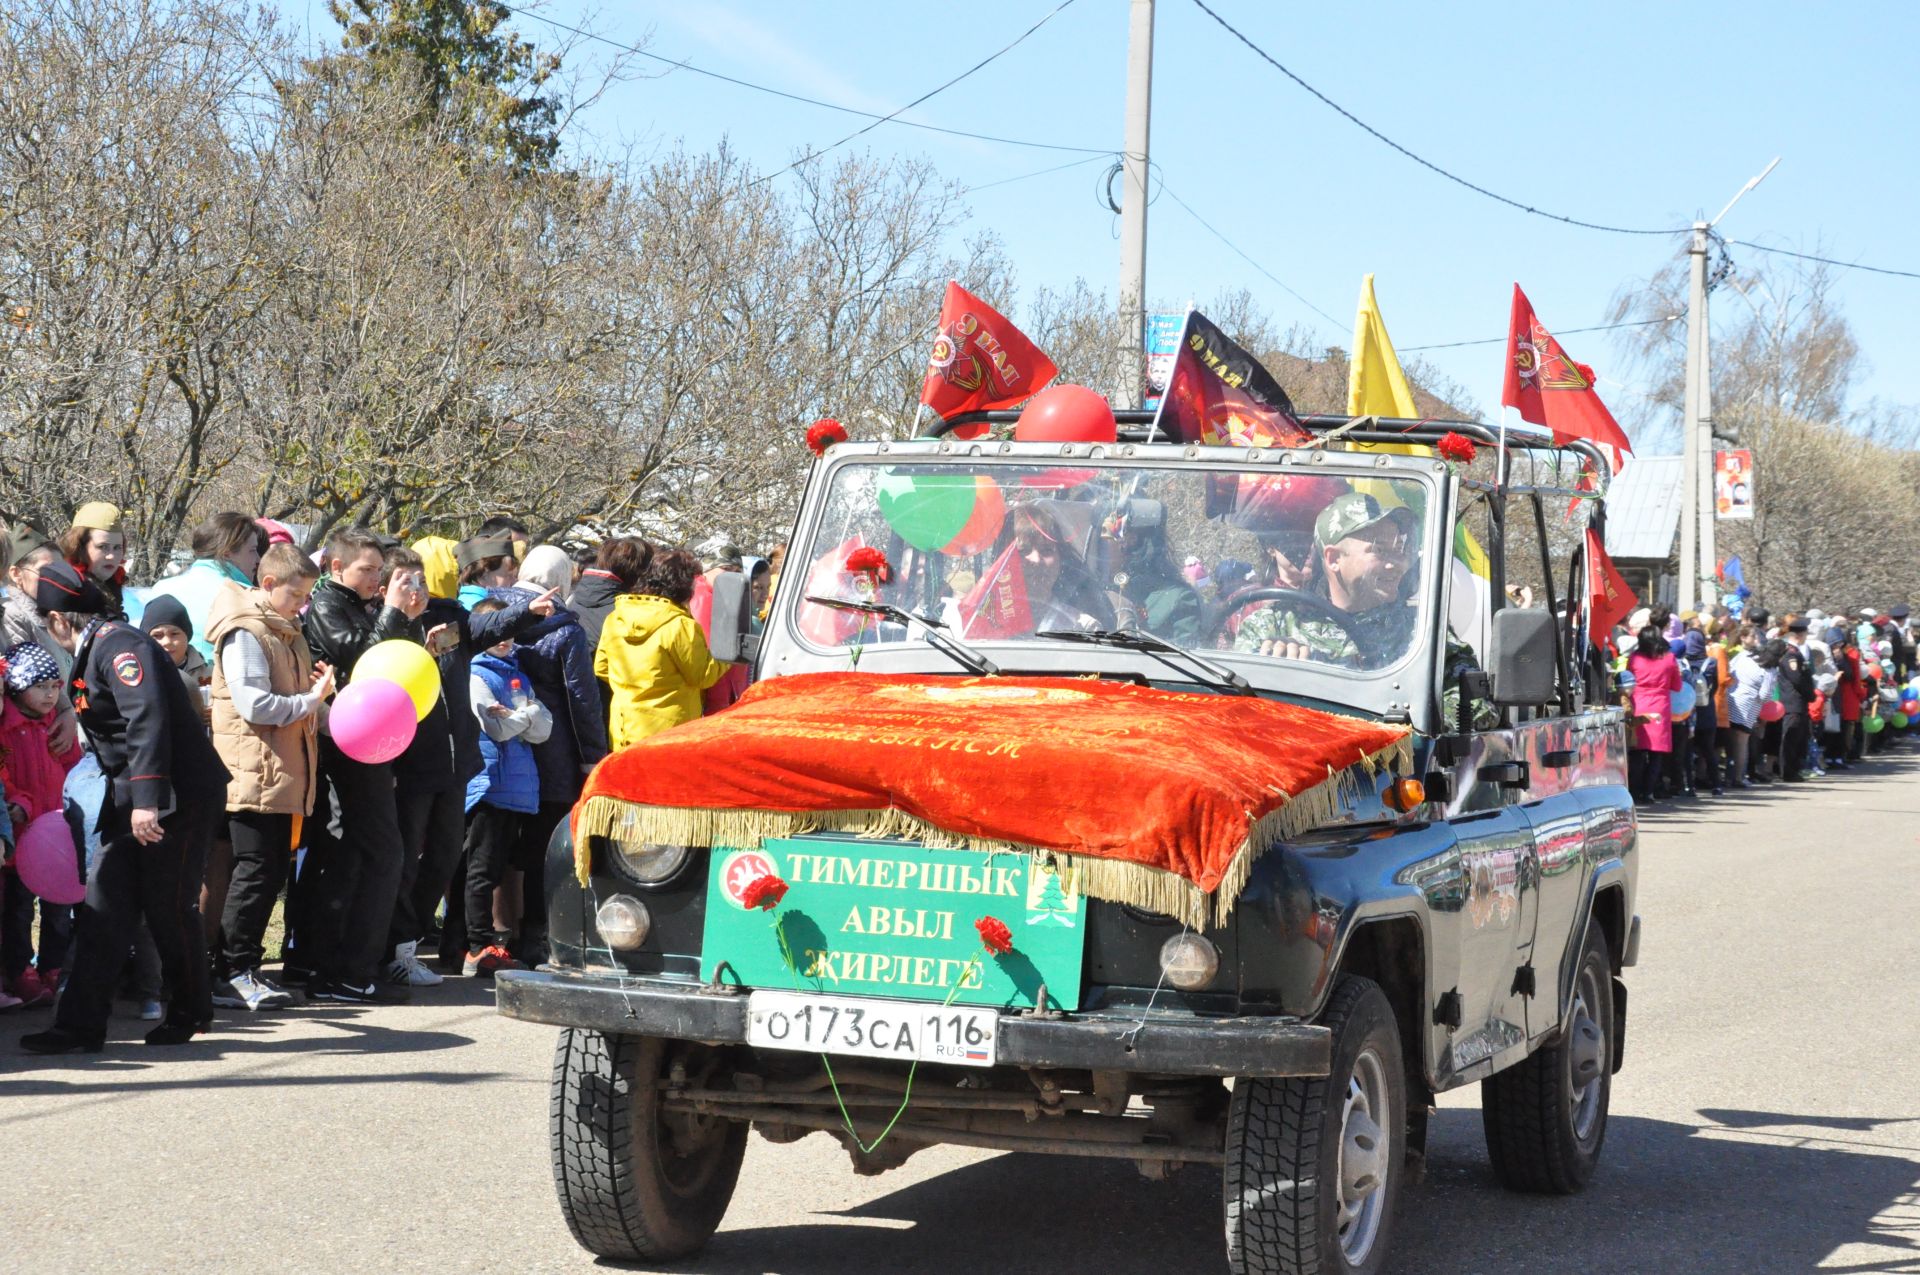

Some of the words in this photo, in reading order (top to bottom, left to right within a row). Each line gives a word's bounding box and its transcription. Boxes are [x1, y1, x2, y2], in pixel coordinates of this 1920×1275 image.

[956, 313, 978, 336] 9
[974, 330, 1020, 387] МАЯ
[1189, 334, 1205, 351] 9
[1201, 348, 1243, 389] МАЯ
[786, 853, 1022, 897] ТИМЕРШЫК
[840, 905, 955, 940] АВЫЛ
[927, 1014, 983, 1046] 116
[936, 1045, 965, 1058] RUS
